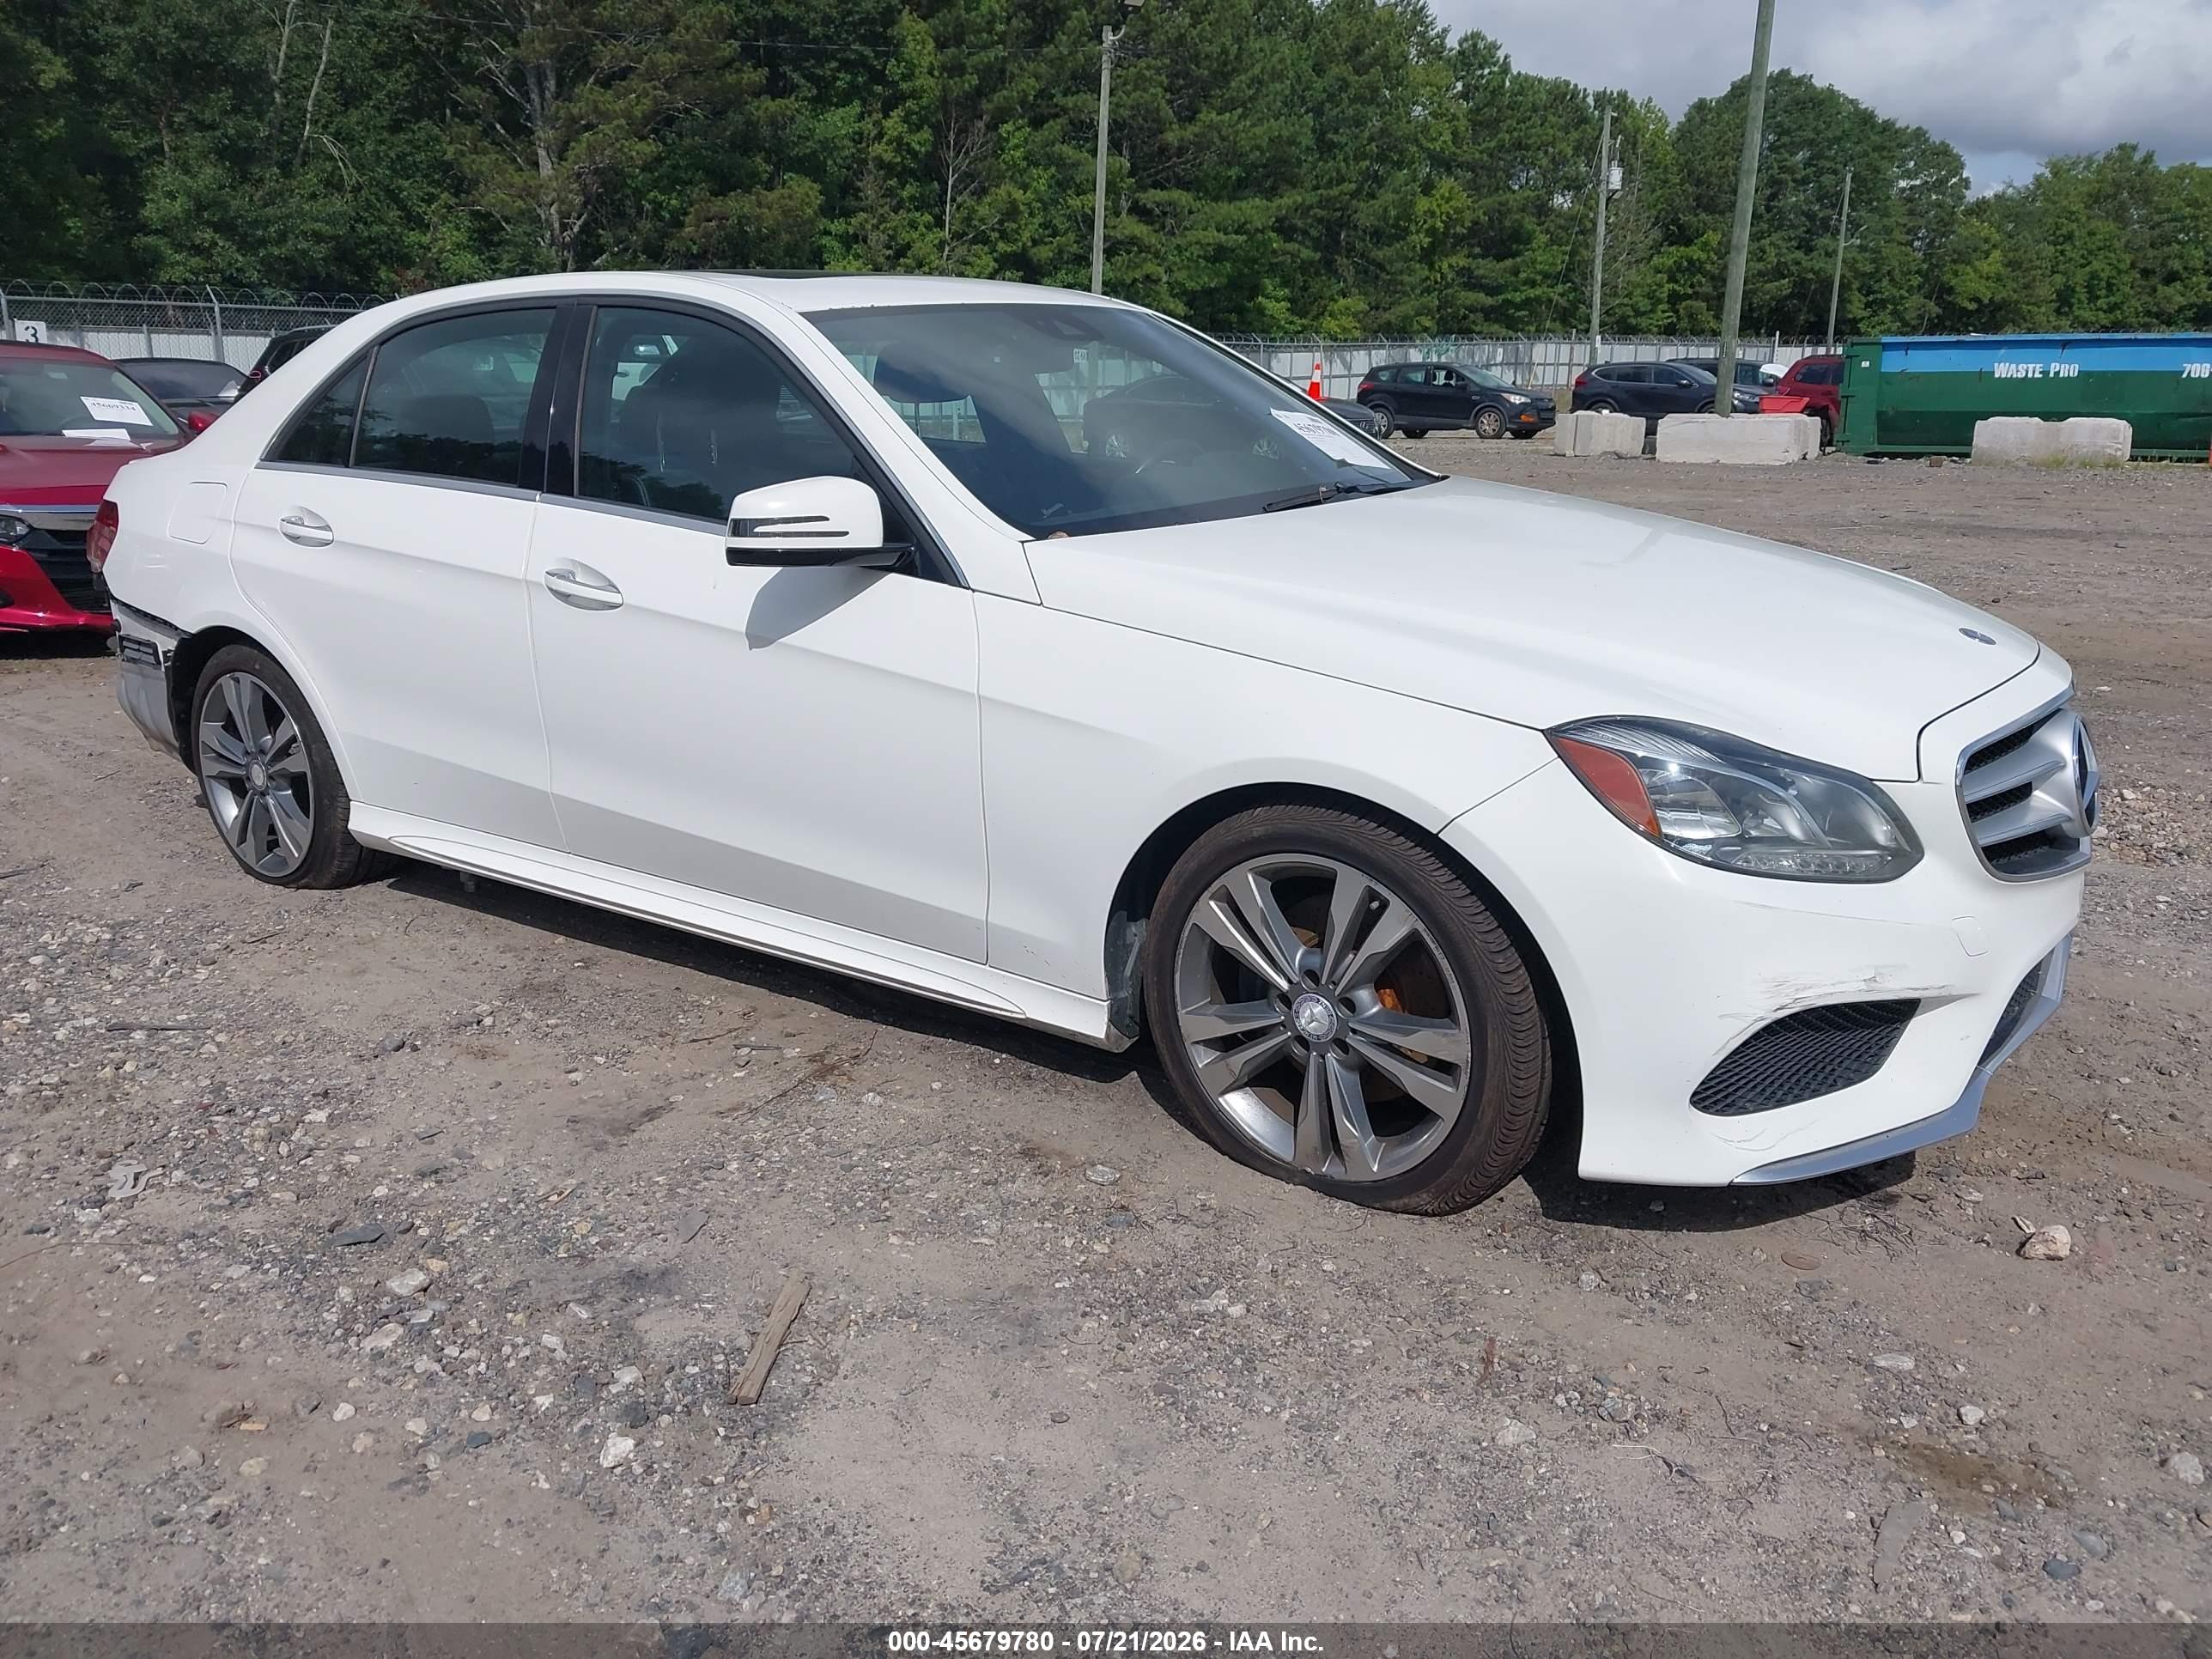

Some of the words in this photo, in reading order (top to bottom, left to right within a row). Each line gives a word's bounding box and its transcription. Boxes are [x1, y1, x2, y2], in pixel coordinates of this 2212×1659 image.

[24, 325, 39, 343] 3
[1994, 362, 2044, 379] WASTE
[2049, 362, 2080, 378] PRO
[2181, 362, 2212, 379] 706
